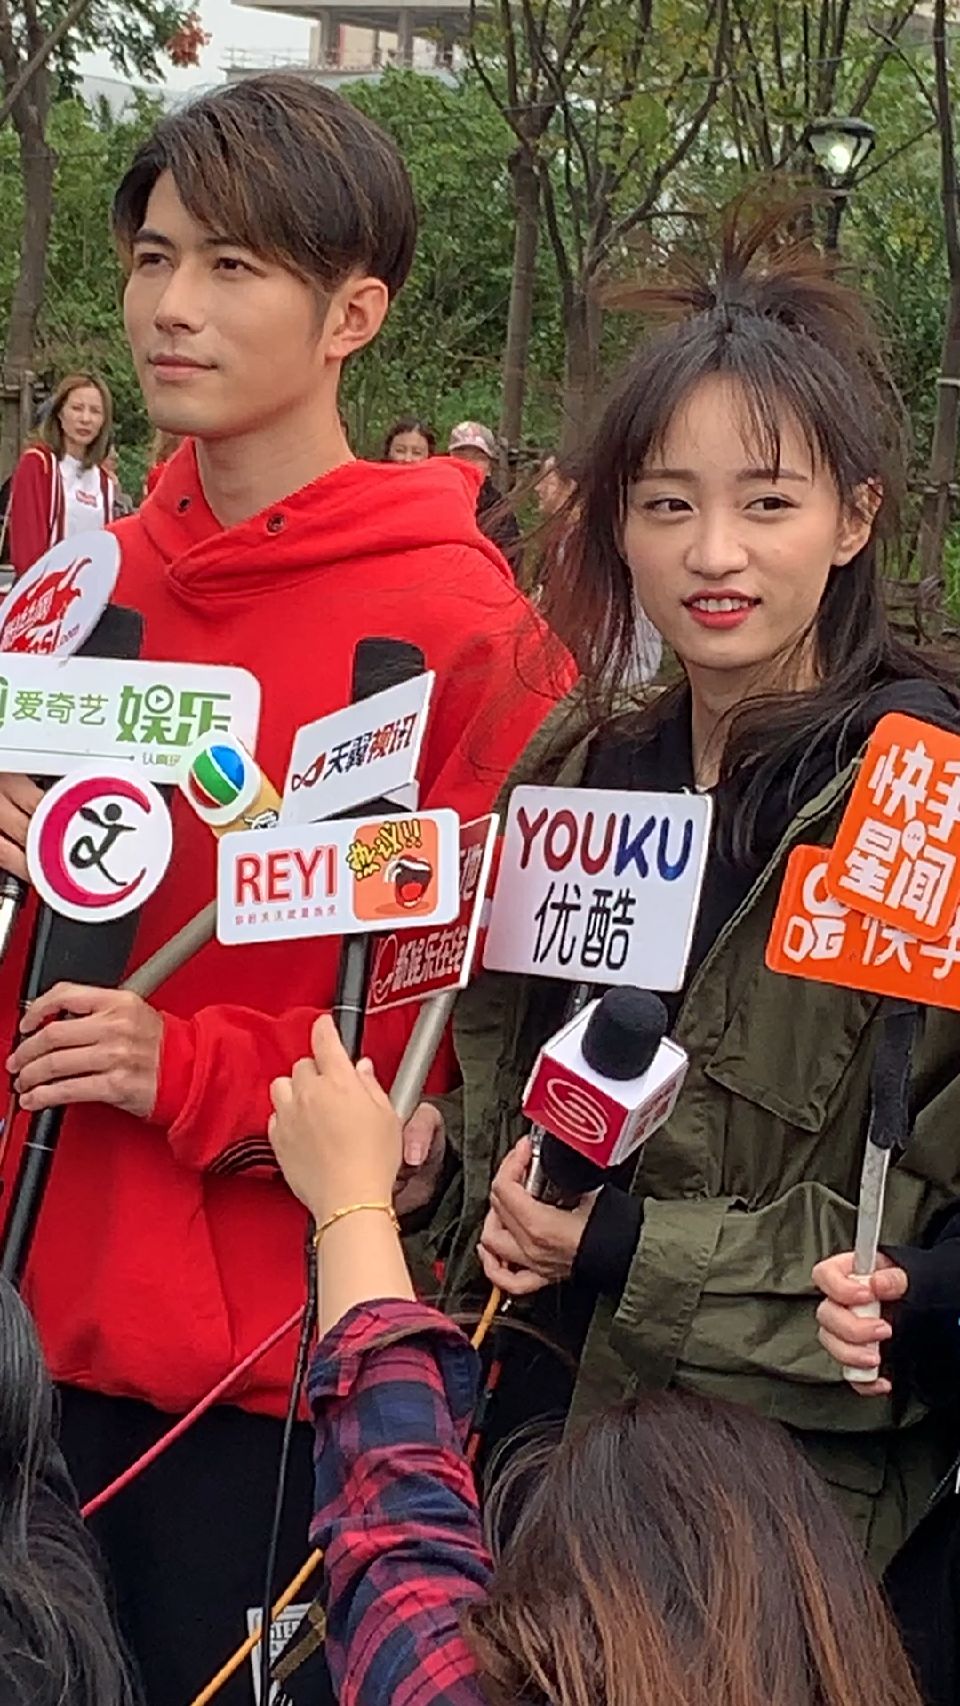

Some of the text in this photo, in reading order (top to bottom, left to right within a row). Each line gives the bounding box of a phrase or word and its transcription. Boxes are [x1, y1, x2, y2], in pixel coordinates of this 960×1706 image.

[12, 684, 231, 747] 爱奇艺 娱乐
[322, 712, 418, 781] 天翼视讯
[867, 739, 960, 844] 快手
[234, 844, 338, 907] REYI
[516, 806, 693, 881] YOUKU
[838, 816, 957, 927] 星闻
[531, 880, 637, 971] 优酷
